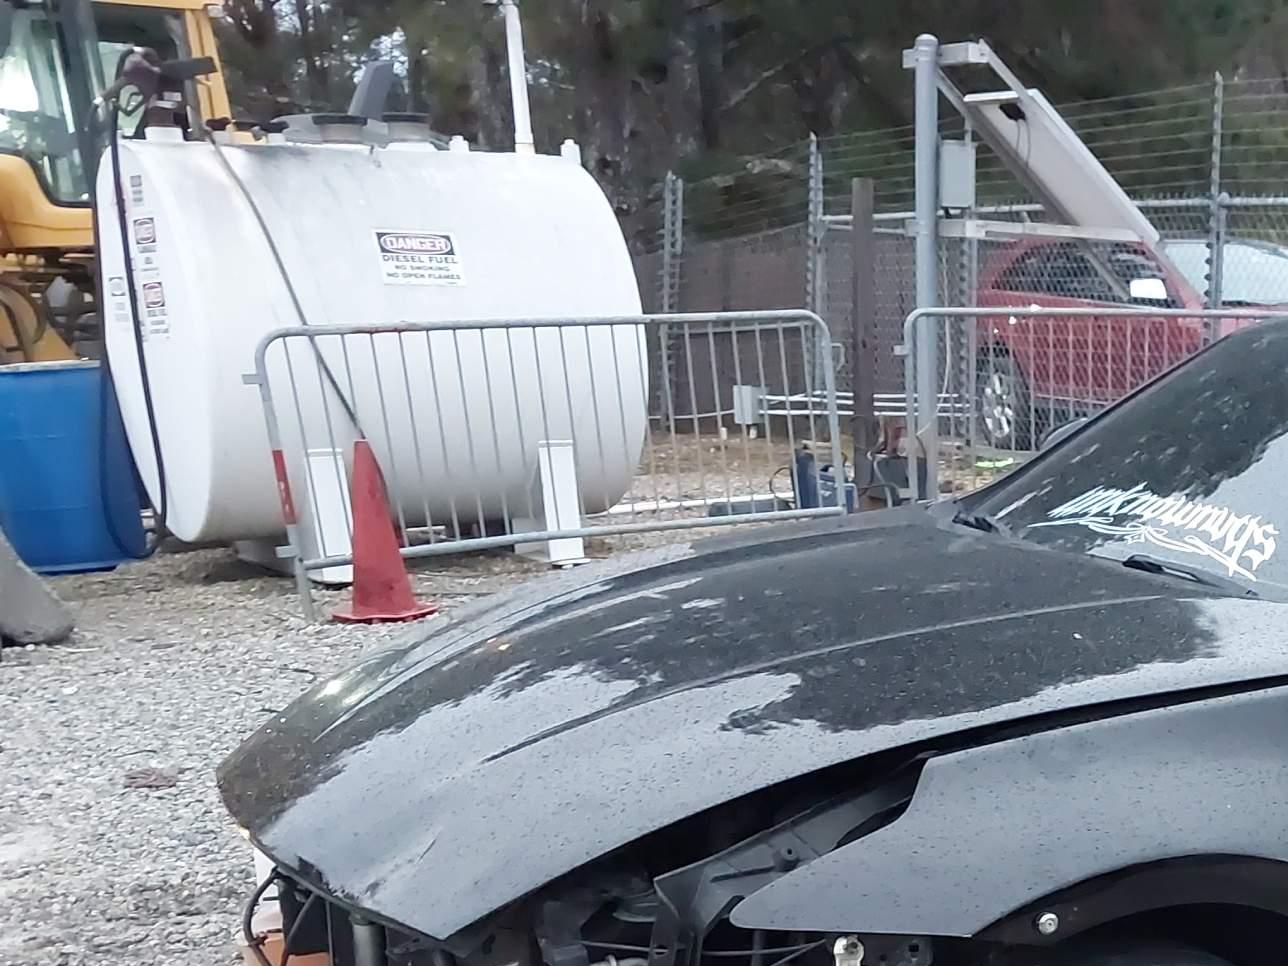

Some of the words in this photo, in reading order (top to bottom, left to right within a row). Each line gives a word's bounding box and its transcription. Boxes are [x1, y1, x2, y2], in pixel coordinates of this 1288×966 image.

[384, 236, 447, 251] DANGER
[382, 254, 425, 263] DIESEL
[428, 256, 459, 264] FUEL
